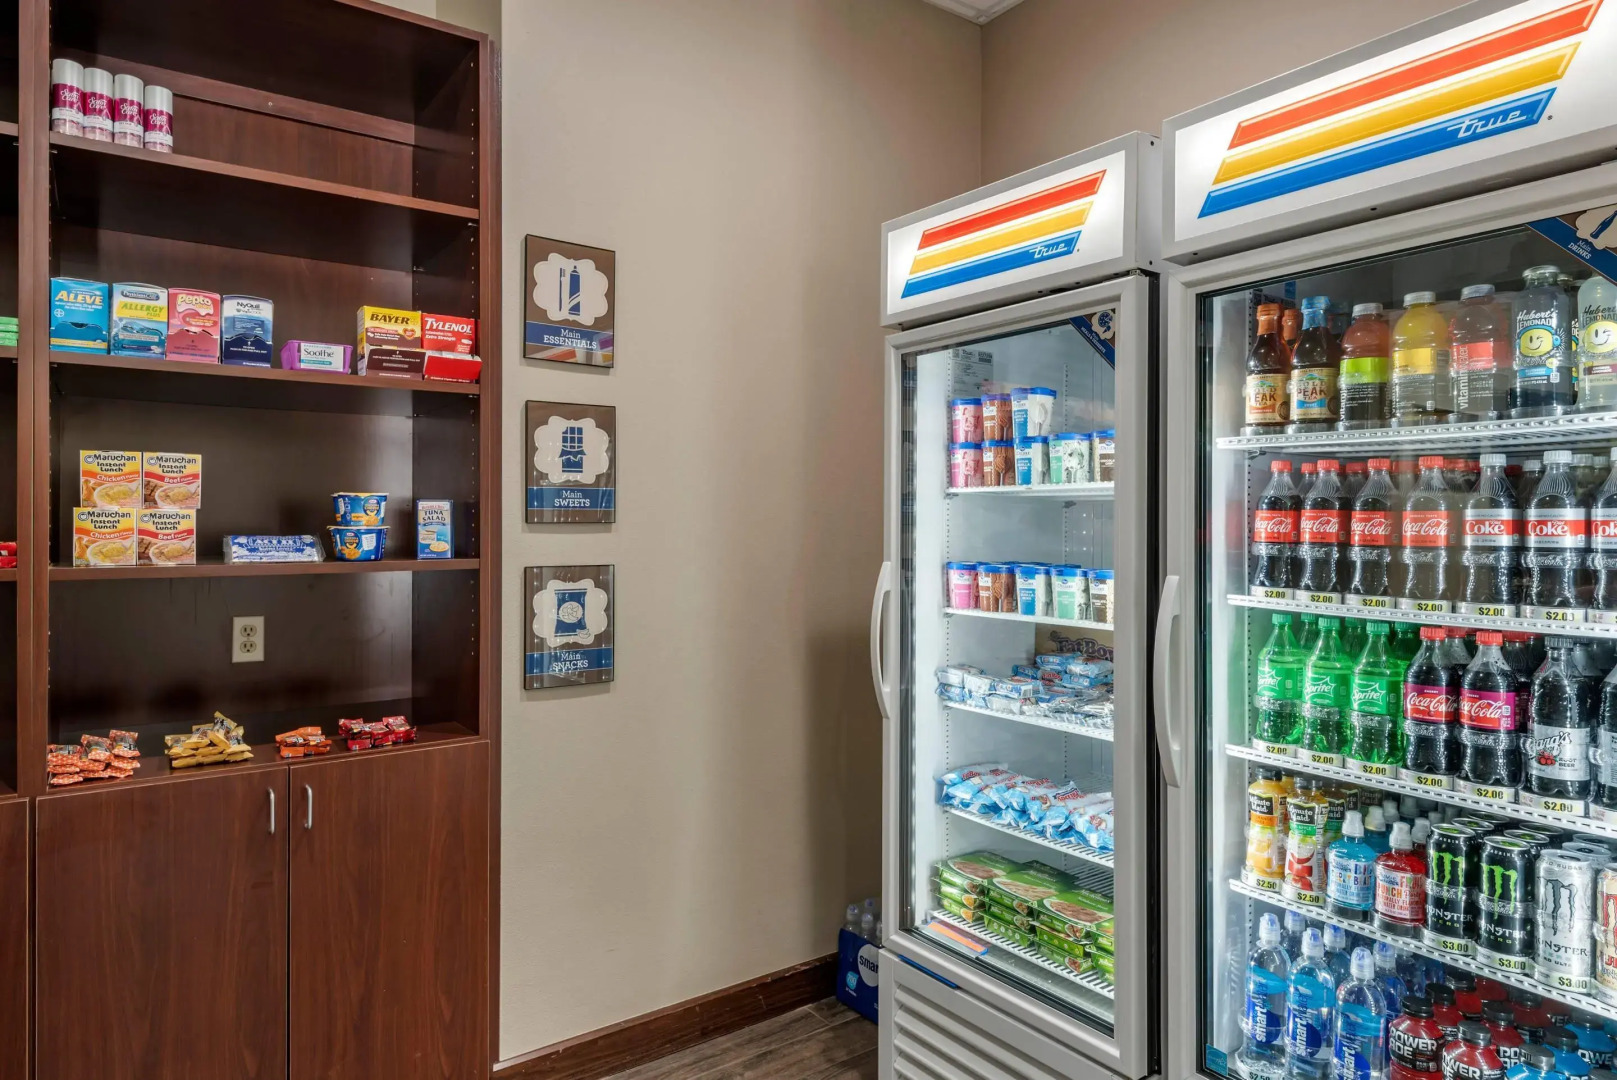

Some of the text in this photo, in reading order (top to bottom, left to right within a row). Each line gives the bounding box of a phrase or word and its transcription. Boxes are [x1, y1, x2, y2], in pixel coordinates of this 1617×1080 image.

[1447, 110, 1526, 138] true
[1029, 243, 1070, 258] true
[1568, 243, 1592, 260] DRINKS
[55, 290, 104, 306] ALEVE
[122, 302, 165, 313] ALLERGY
[237, 301, 260, 309] NyQuil
[370, 314, 410, 324] BAYER
[425, 318, 472, 334] TYLENOL
[561, 329, 580, 338] Main
[544, 335, 597, 349] ESSENTIALS
[304, 348, 334, 357] Soothe
[156, 456, 196, 464] Maruchan
[1351, 518, 1392, 536] Coca-Cola
[1402, 518, 1450, 536] Coca-Cola
[1465, 520, 1505, 535] Coke
[1528, 521, 1568, 536] Coke
[1264, 590, 1286, 599] $2.00
[1310, 594, 1333, 603] $2.00
[1362, 598, 1386, 608] $2.00
[1418, 602, 1442, 612] $2.00
[1478, 607, 1505, 616] $2.00
[561, 652, 581, 661] Main
[553, 660, 588, 671] SNACKS
[1304, 683, 1331, 693] Sprite
[1352, 690, 1381, 700] Sprite
[1406, 692, 1456, 712] Coca-Cola
[1266, 746, 1287, 755] $2.00
[1312, 755, 1334, 764] $2.00
[1363, 765, 1387, 775] $2.00
[1417, 776, 1443, 787] $2.00
[1476, 788, 1504, 799] $2.00
[1544, 801, 1572, 812] $2.00
[1256, 879, 1277, 889] $2.50
[1297, 892, 1320, 903] $2.50
[1426, 905, 1473, 922] MONSTER
[1479, 921, 1528, 940] MONSTER
[1442, 941, 1469, 952] $3.00
[1535, 938, 1588, 956] MONSTER
[1498, 958, 1526, 970] $3.00
[1558, 976, 1587, 989] $3.00
[1255, 1005, 1267, 1042] smart
[1296, 1018, 1307, 1056] smart
[1390, 1027, 1437, 1052] POWER
[1390, 1038, 1413, 1059] ADE
